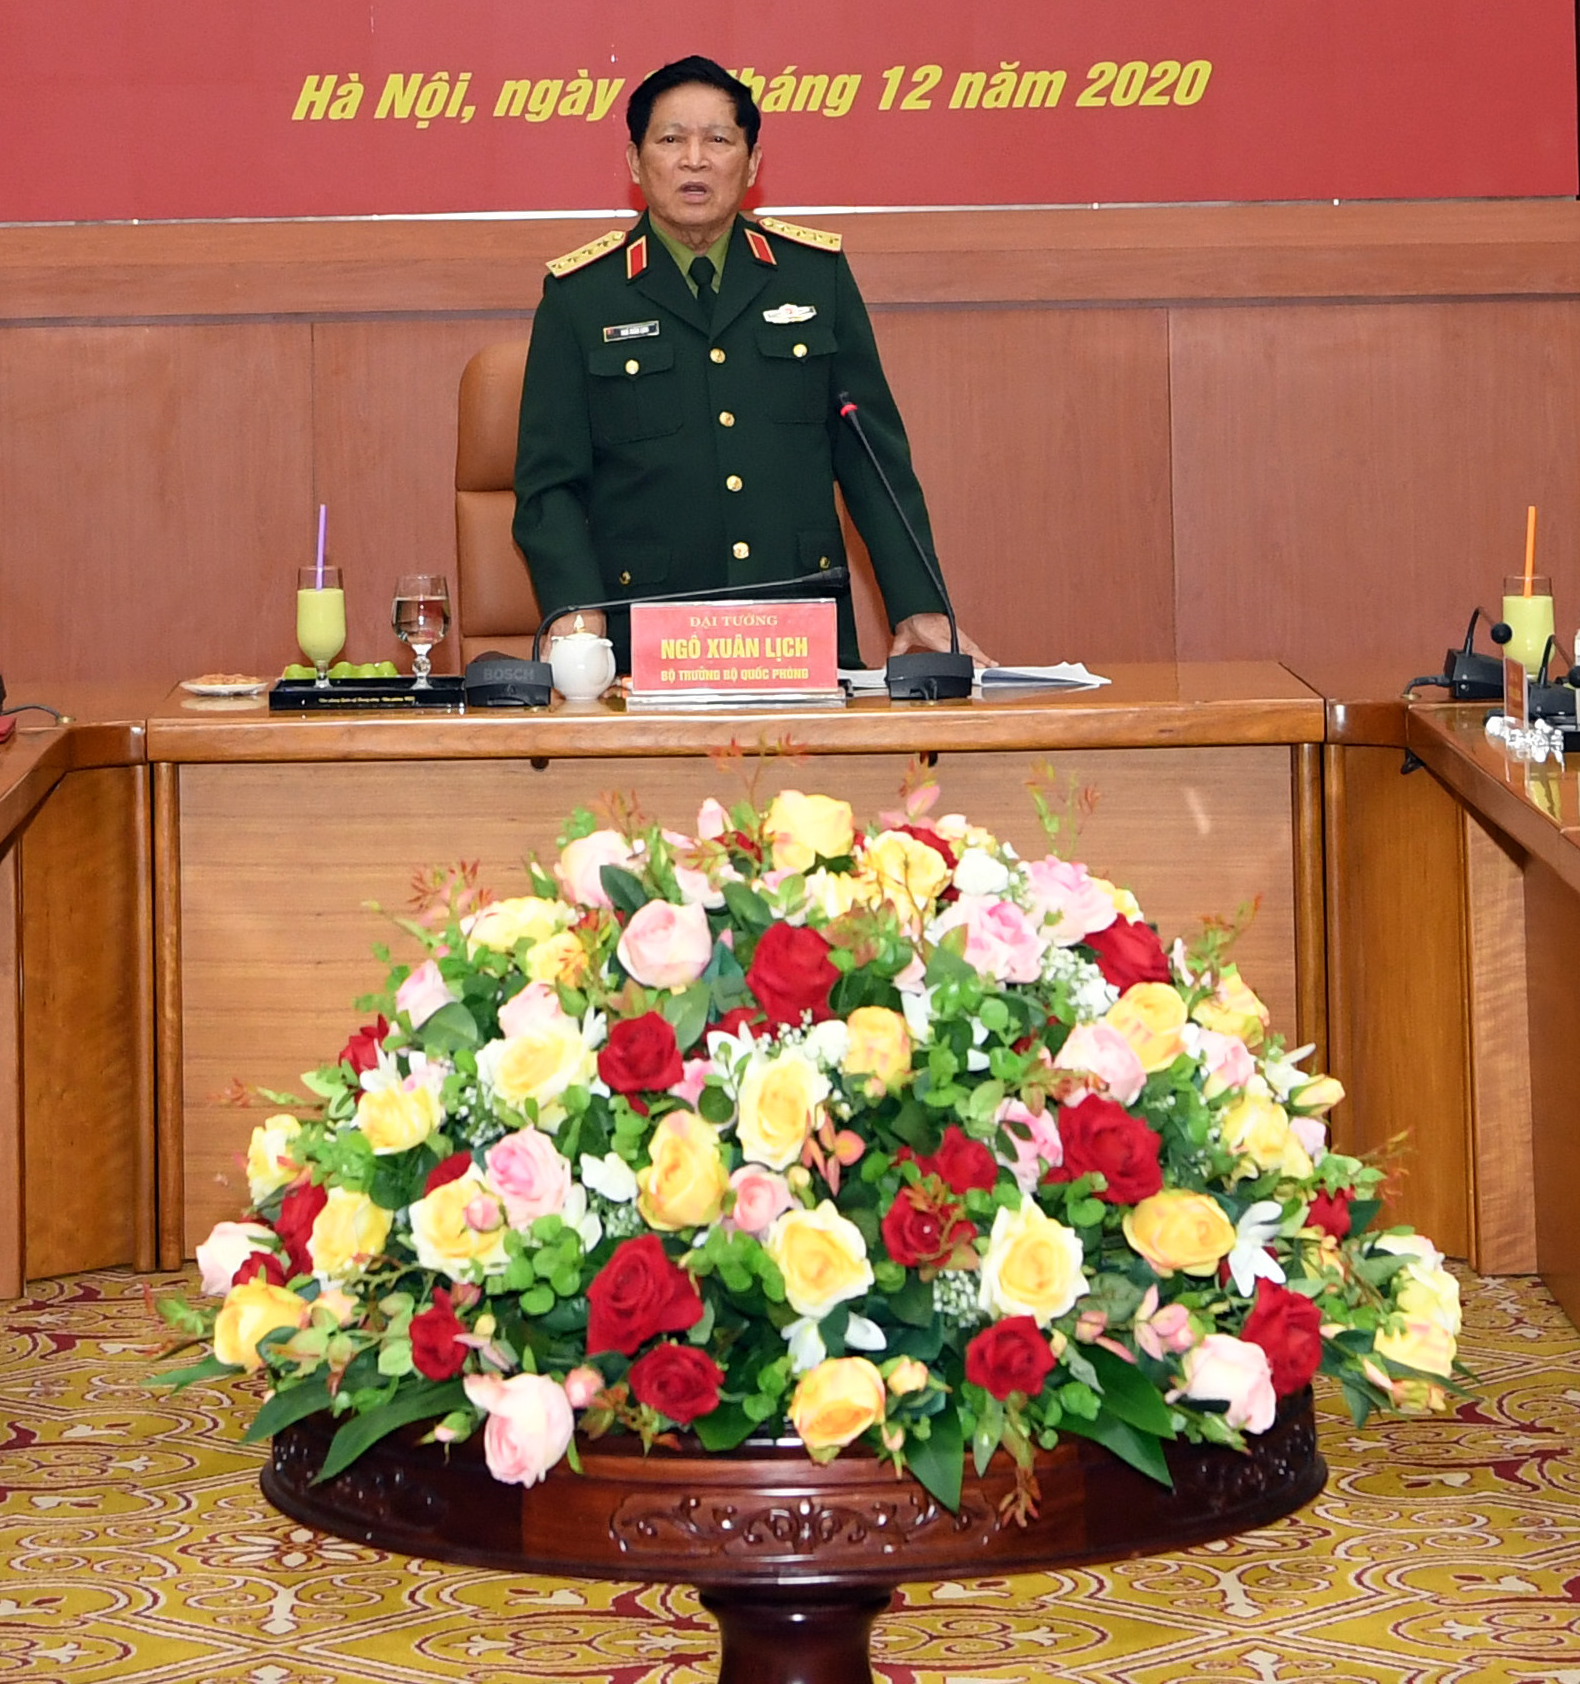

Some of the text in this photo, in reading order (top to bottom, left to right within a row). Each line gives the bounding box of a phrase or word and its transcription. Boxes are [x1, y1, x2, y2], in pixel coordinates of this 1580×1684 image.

[292, 58, 1214, 129] Hà Nội, ngày háng 12 năm 2020
[689, 613, 779, 630] ĐẠI TƯỚNG
[660, 632, 809, 663] NGÔ XUÂN LỊCH
[483, 667, 536, 681] BOSCH
[660, 668, 676, 685] BỘ
